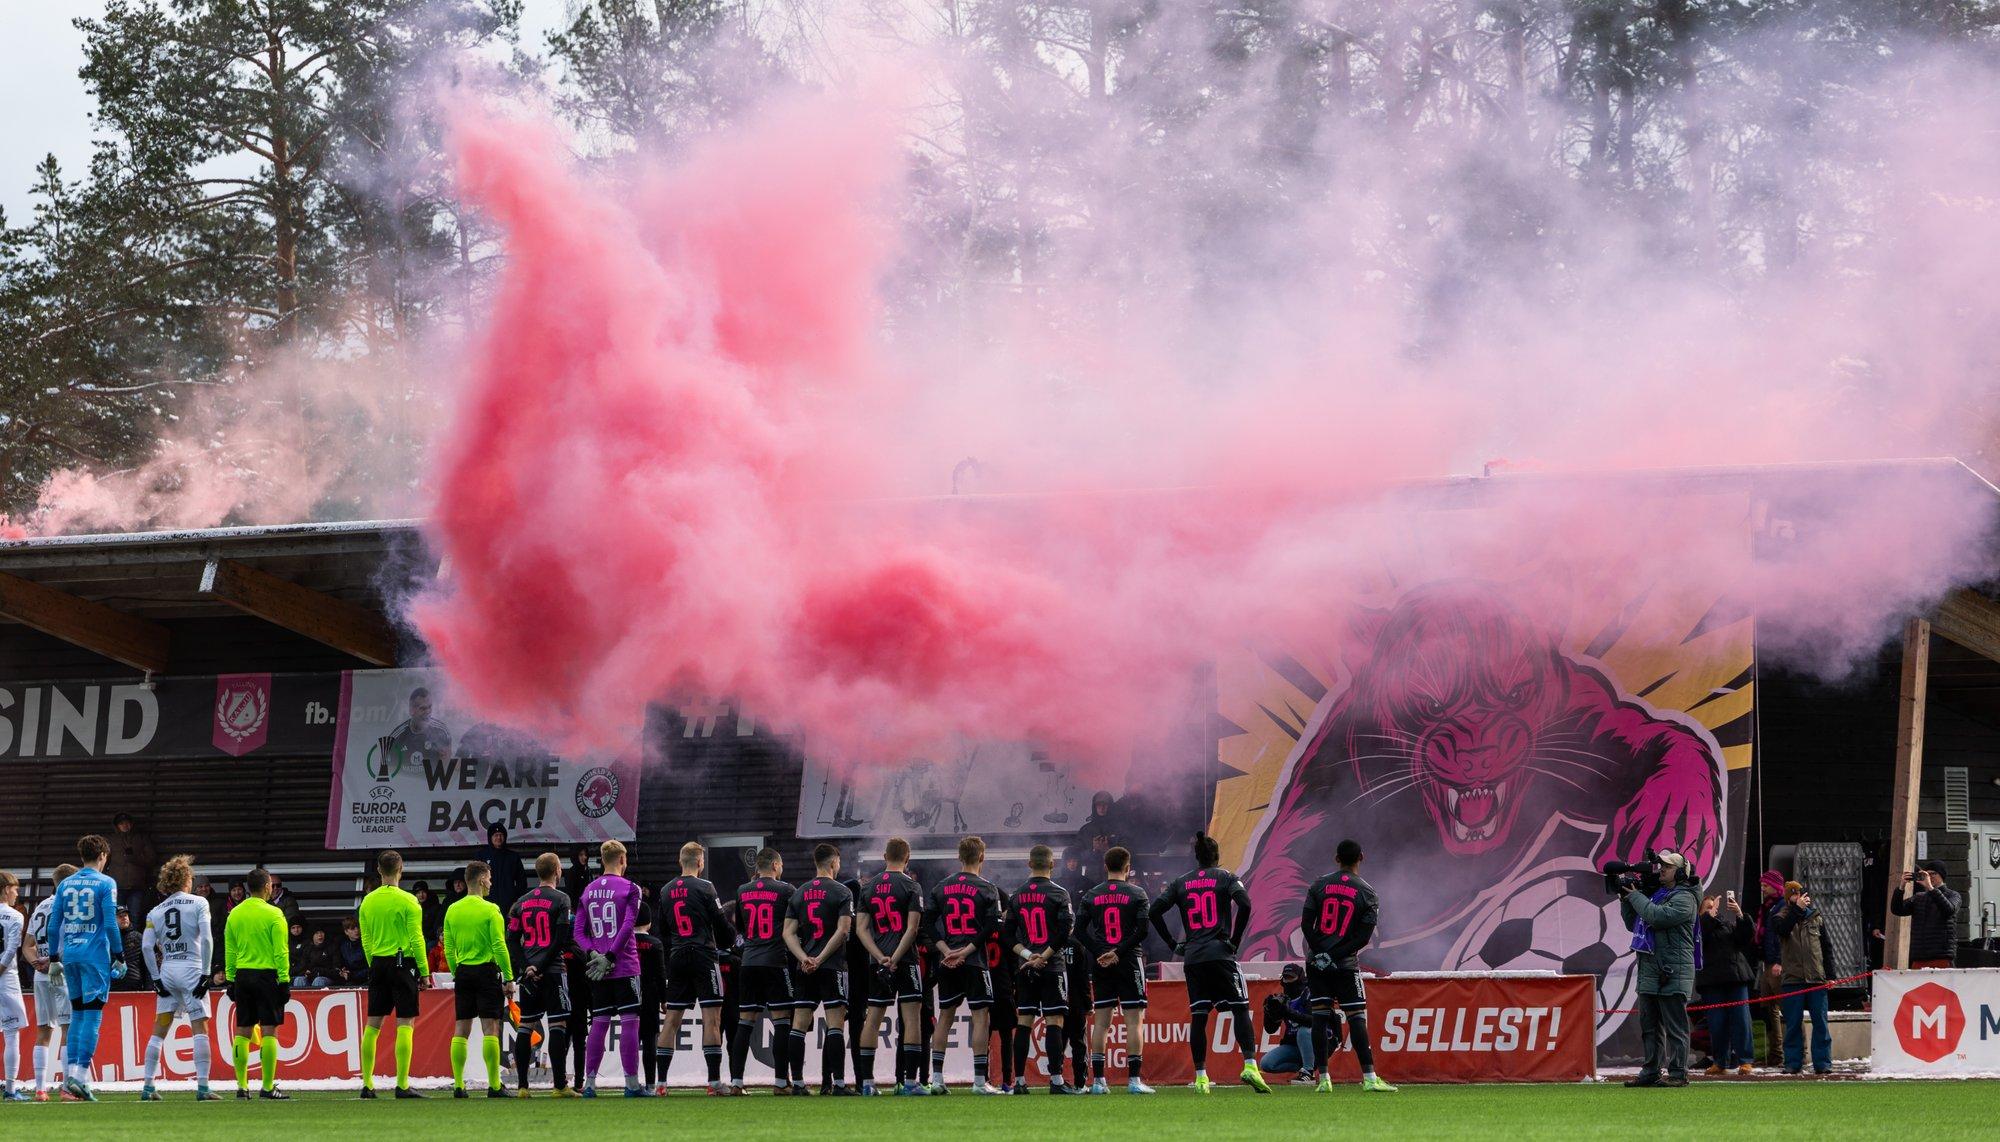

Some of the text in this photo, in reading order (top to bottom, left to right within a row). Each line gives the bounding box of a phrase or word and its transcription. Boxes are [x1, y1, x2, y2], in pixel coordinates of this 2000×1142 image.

[229, 693, 252, 723] KALJU
[369, 785, 395, 798] UEFA
[422, 756, 560, 791] WE ARE
[352, 802, 407, 815] EUROPA
[352, 815, 407, 824] CONFERENCE
[428, 798, 547, 833] BACK!
[361, 825, 394, 833] LEAGUE
[62, 887, 95, 921] 33
[588, 889, 616, 899] PAVLOV
[1186, 891, 1219, 930] 20
[165, 908, 182, 940] 9
[521, 911, 551, 948] 50
[588, 901, 618, 939] 69
[673, 900, 693, 938] 6
[743, 903, 774, 940] 78
[807, 901, 825, 940] 5
[871, 896, 903, 934] 26
[946, 897, 978, 935] 22
[1020, 906, 1049, 945] 10
[1103, 906, 1123, 945] 8
[1319, 897, 1355, 937] 87
[1091, 1023, 1191, 1043] REIUM
[1380, 1006, 1562, 1052] SELLEST!
[1912, 1005, 1946, 1039] M
